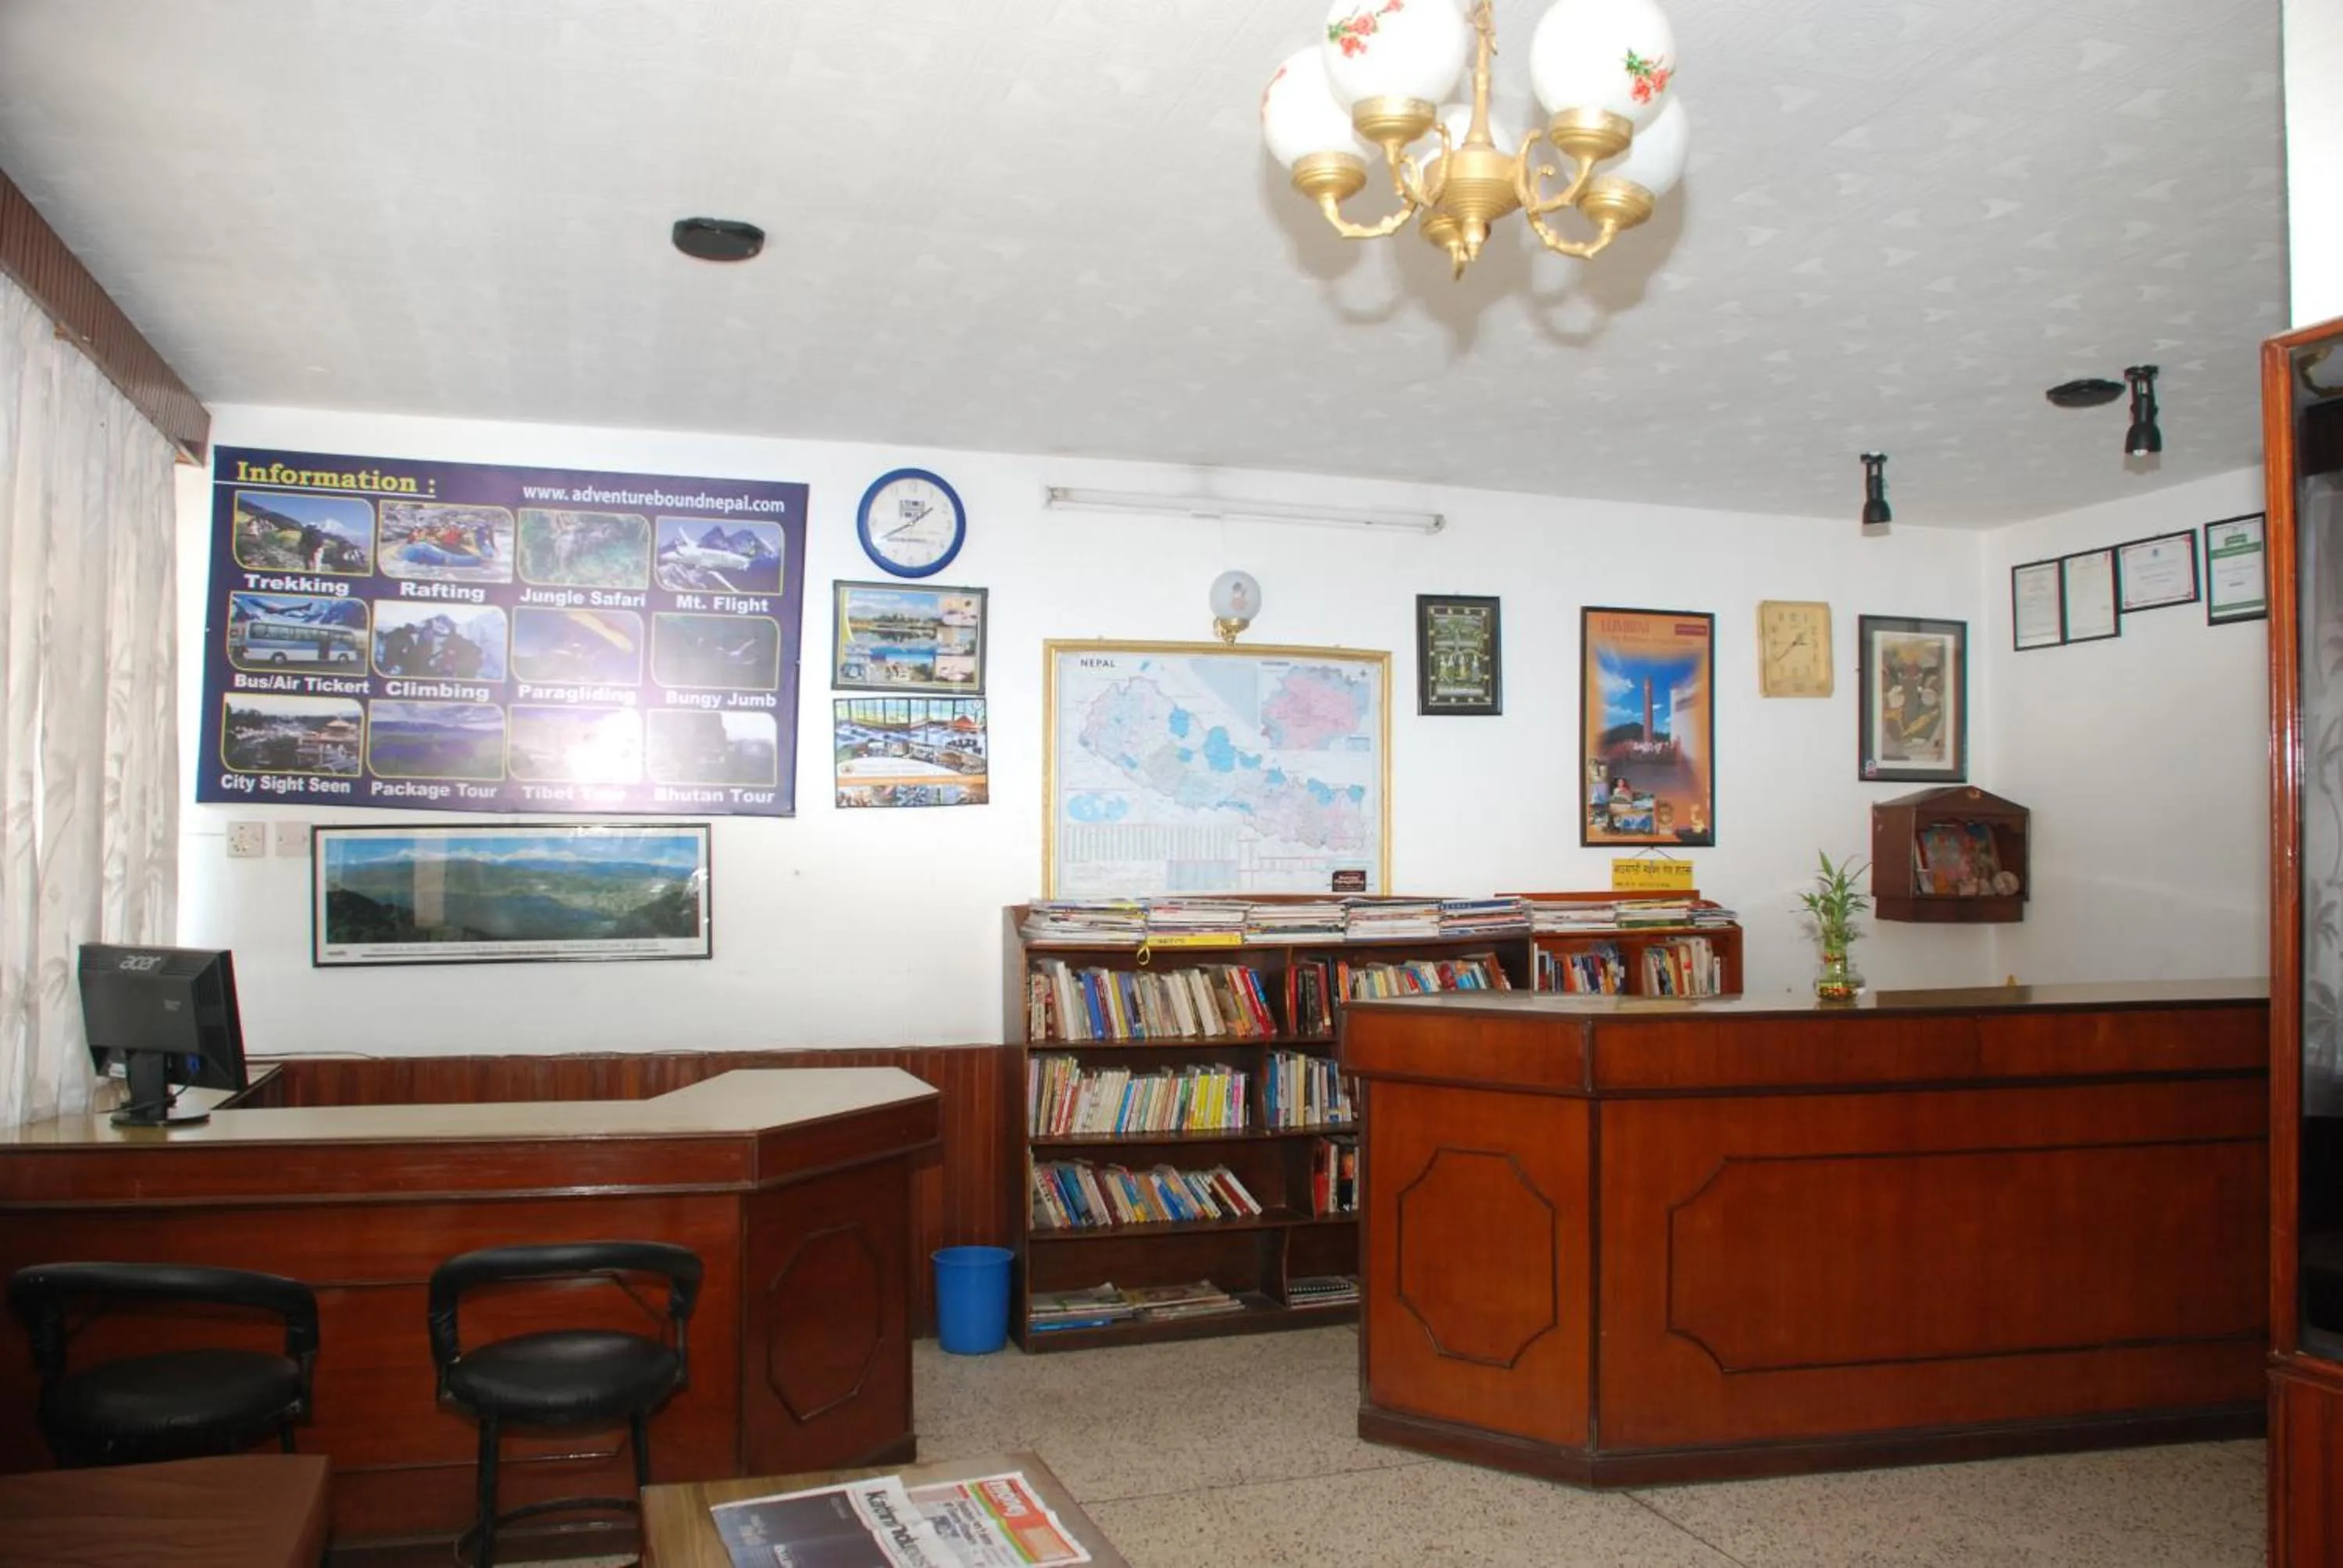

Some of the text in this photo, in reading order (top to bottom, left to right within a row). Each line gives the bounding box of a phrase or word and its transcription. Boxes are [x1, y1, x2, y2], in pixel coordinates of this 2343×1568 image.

[237, 461, 417, 493] Information
[522, 486, 785, 514] www. adventureboundnepal.com
[243, 573, 350, 597] Trekking
[400, 582, 485, 602] Rafting
[519, 588, 646, 608] Jungle Safari
[676, 595, 769, 613] Mt. Flight
[1080, 659, 1116, 668] NEPAL
[234, 674, 370, 694] Bus/Air Tickert
[386, 681, 490, 702] Climbing
[518, 685, 637, 706] Paragliding
[665, 690, 777, 709] Bungy Jumb
[221, 775, 351, 793] City Sight Seen
[371, 782, 498, 800] Package Tour
[522, 786, 573, 800] Tibet
[729, 789, 776, 804] Tour
[119, 955, 162, 971] acer
